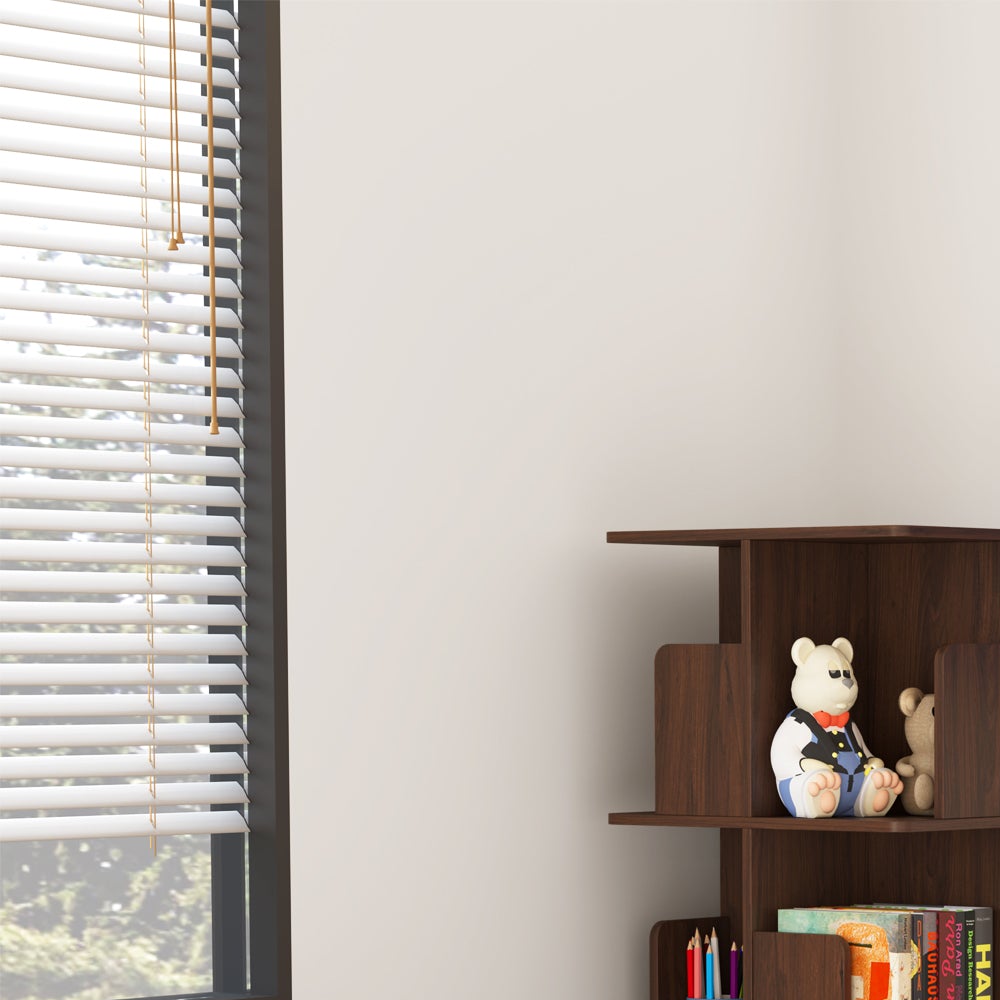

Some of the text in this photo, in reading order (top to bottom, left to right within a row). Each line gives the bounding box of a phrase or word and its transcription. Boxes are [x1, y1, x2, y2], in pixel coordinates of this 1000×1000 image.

[941, 915, 955, 977] Parr
[955, 923, 963, 977] Ron Arad
